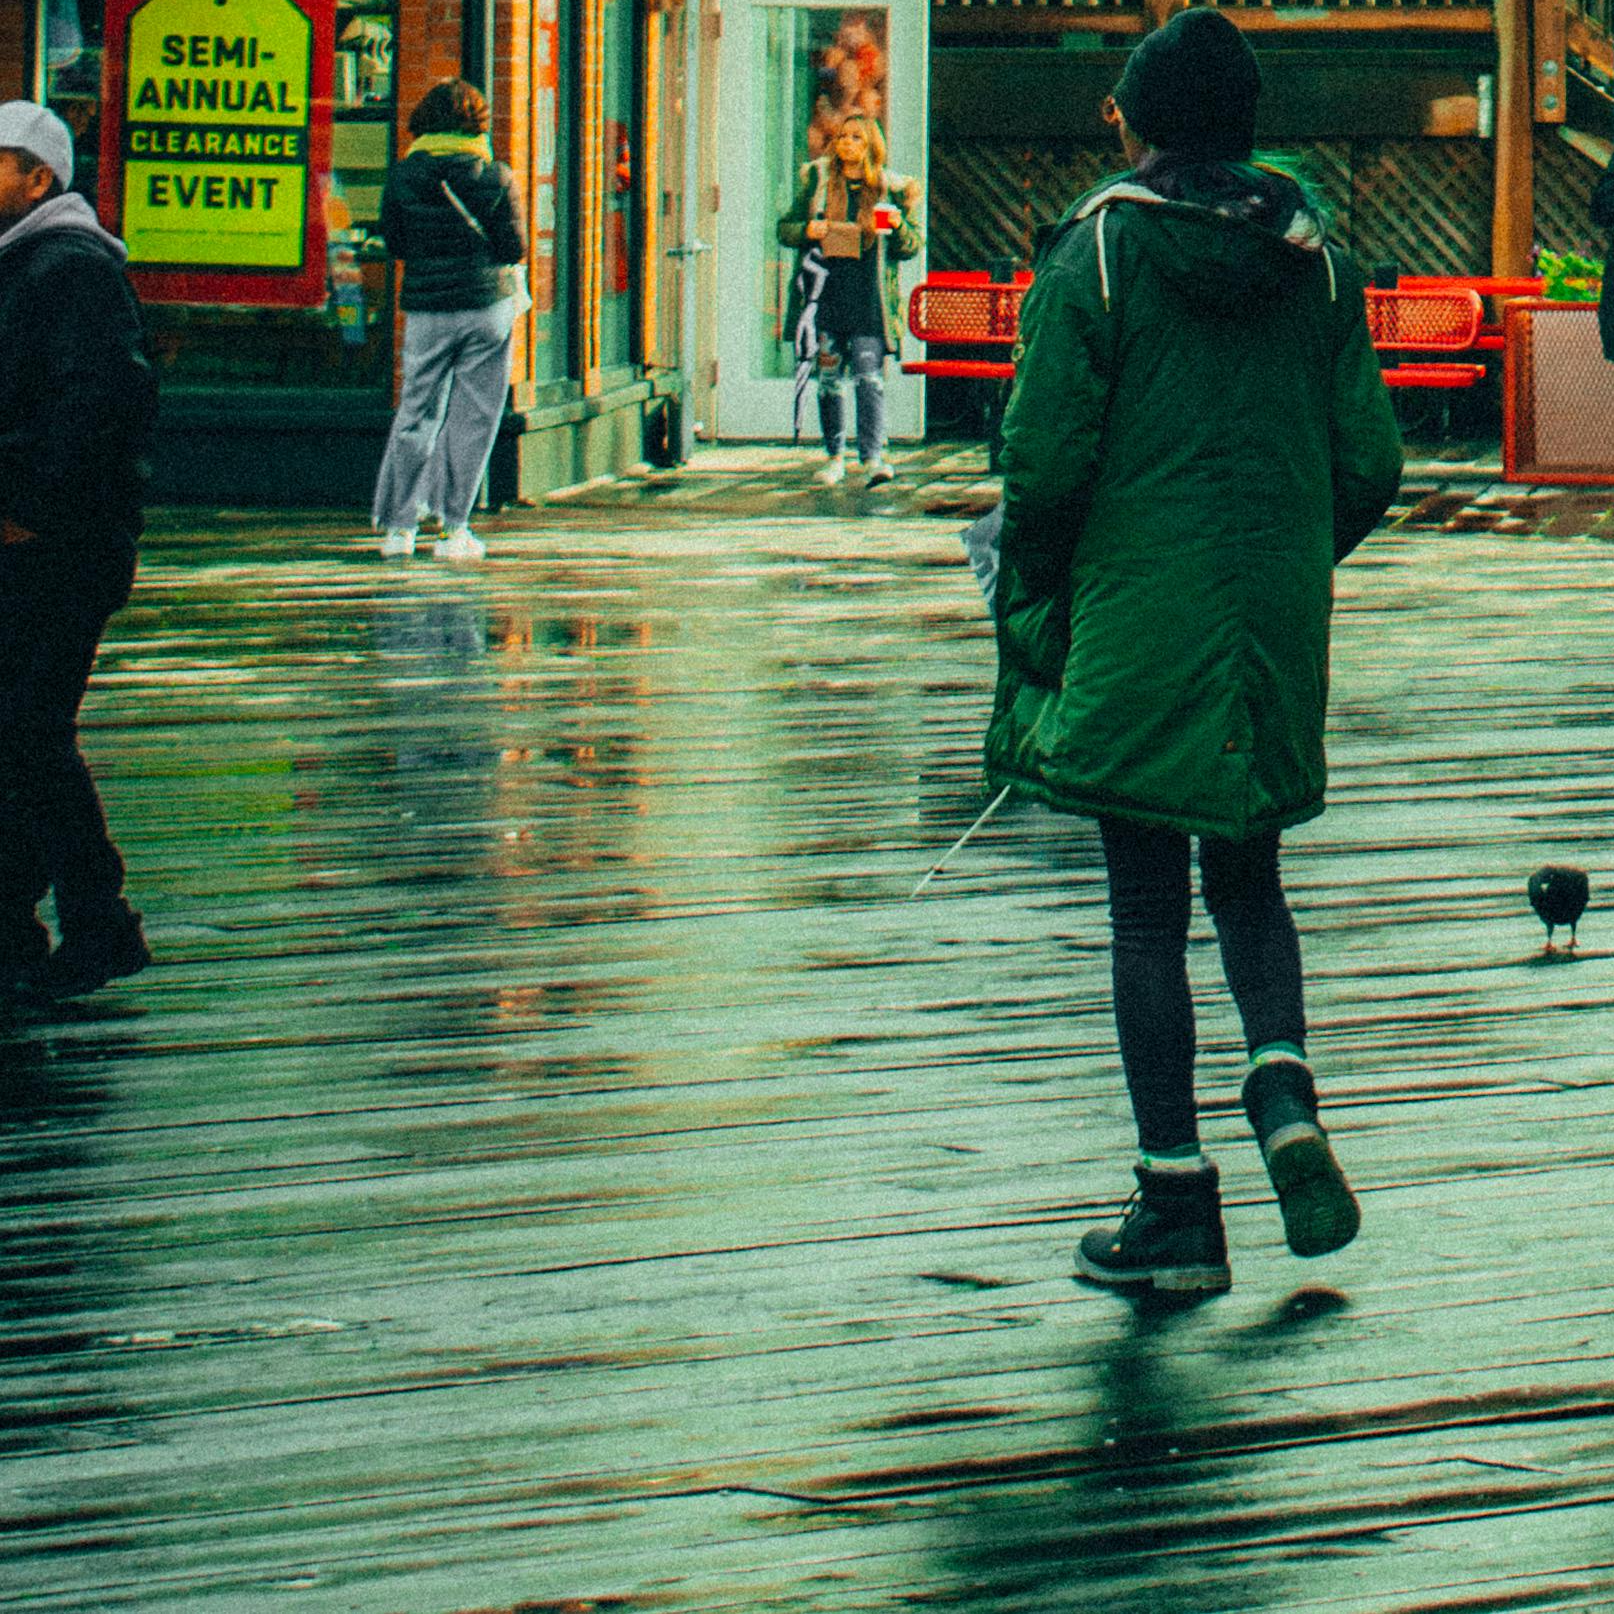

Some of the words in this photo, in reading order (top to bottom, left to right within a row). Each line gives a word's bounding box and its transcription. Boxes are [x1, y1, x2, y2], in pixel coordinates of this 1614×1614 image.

[161, 34, 276, 69] SEMI-
[135, 77, 299, 114] ANNUAL
[131, 130, 299, 157] CLEARANCE
[148, 174, 279, 210] EVENT
